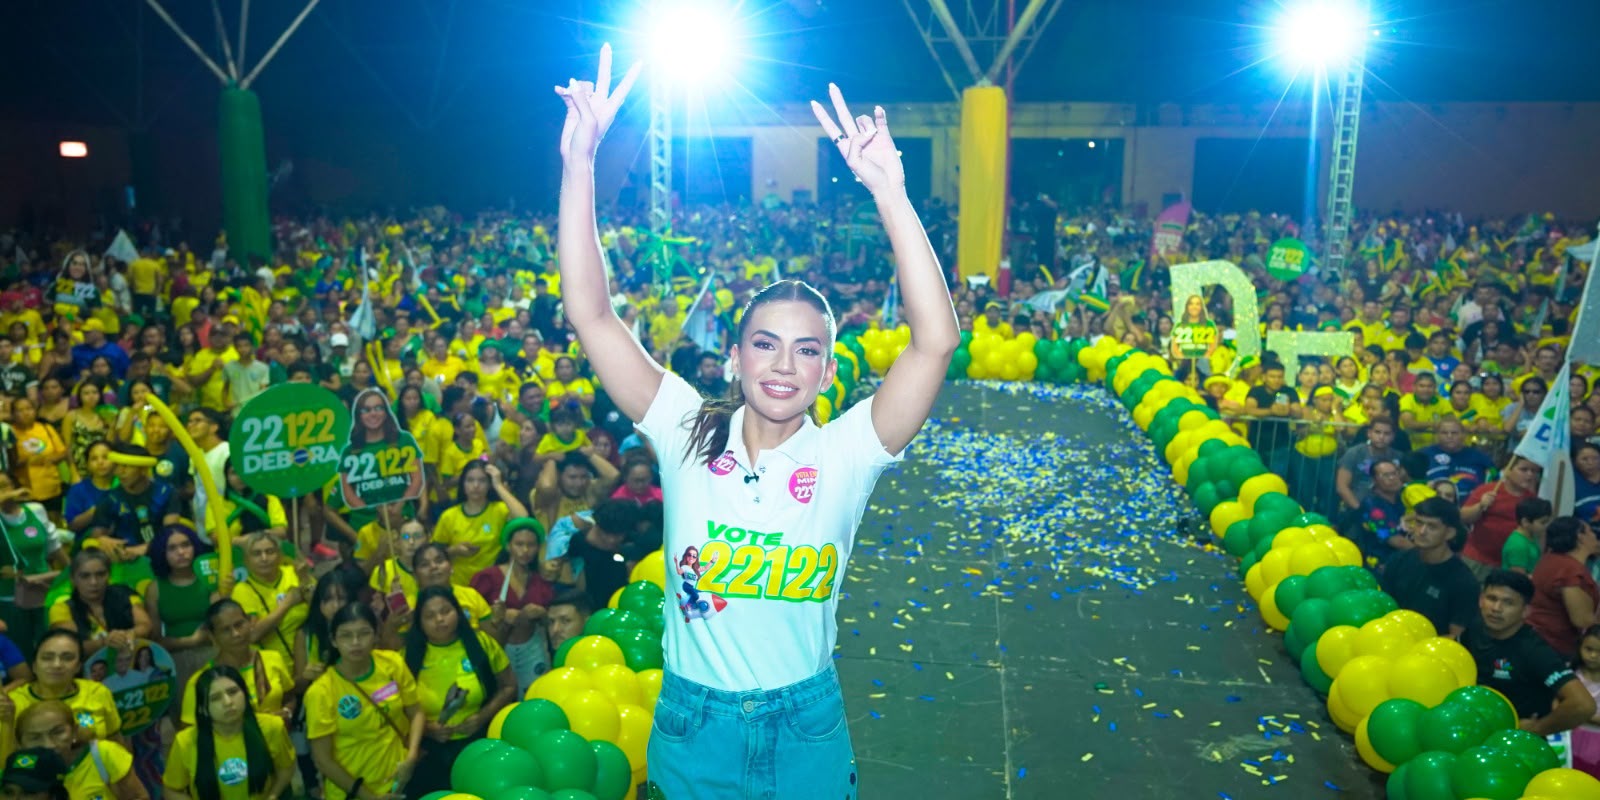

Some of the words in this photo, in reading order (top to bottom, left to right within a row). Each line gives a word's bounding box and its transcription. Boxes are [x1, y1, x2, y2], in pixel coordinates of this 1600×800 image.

[242, 408, 335, 452] 22122
[344, 446, 418, 484] 22122
[707, 520, 784, 546] VOTE
[697, 541, 838, 602] 22122
